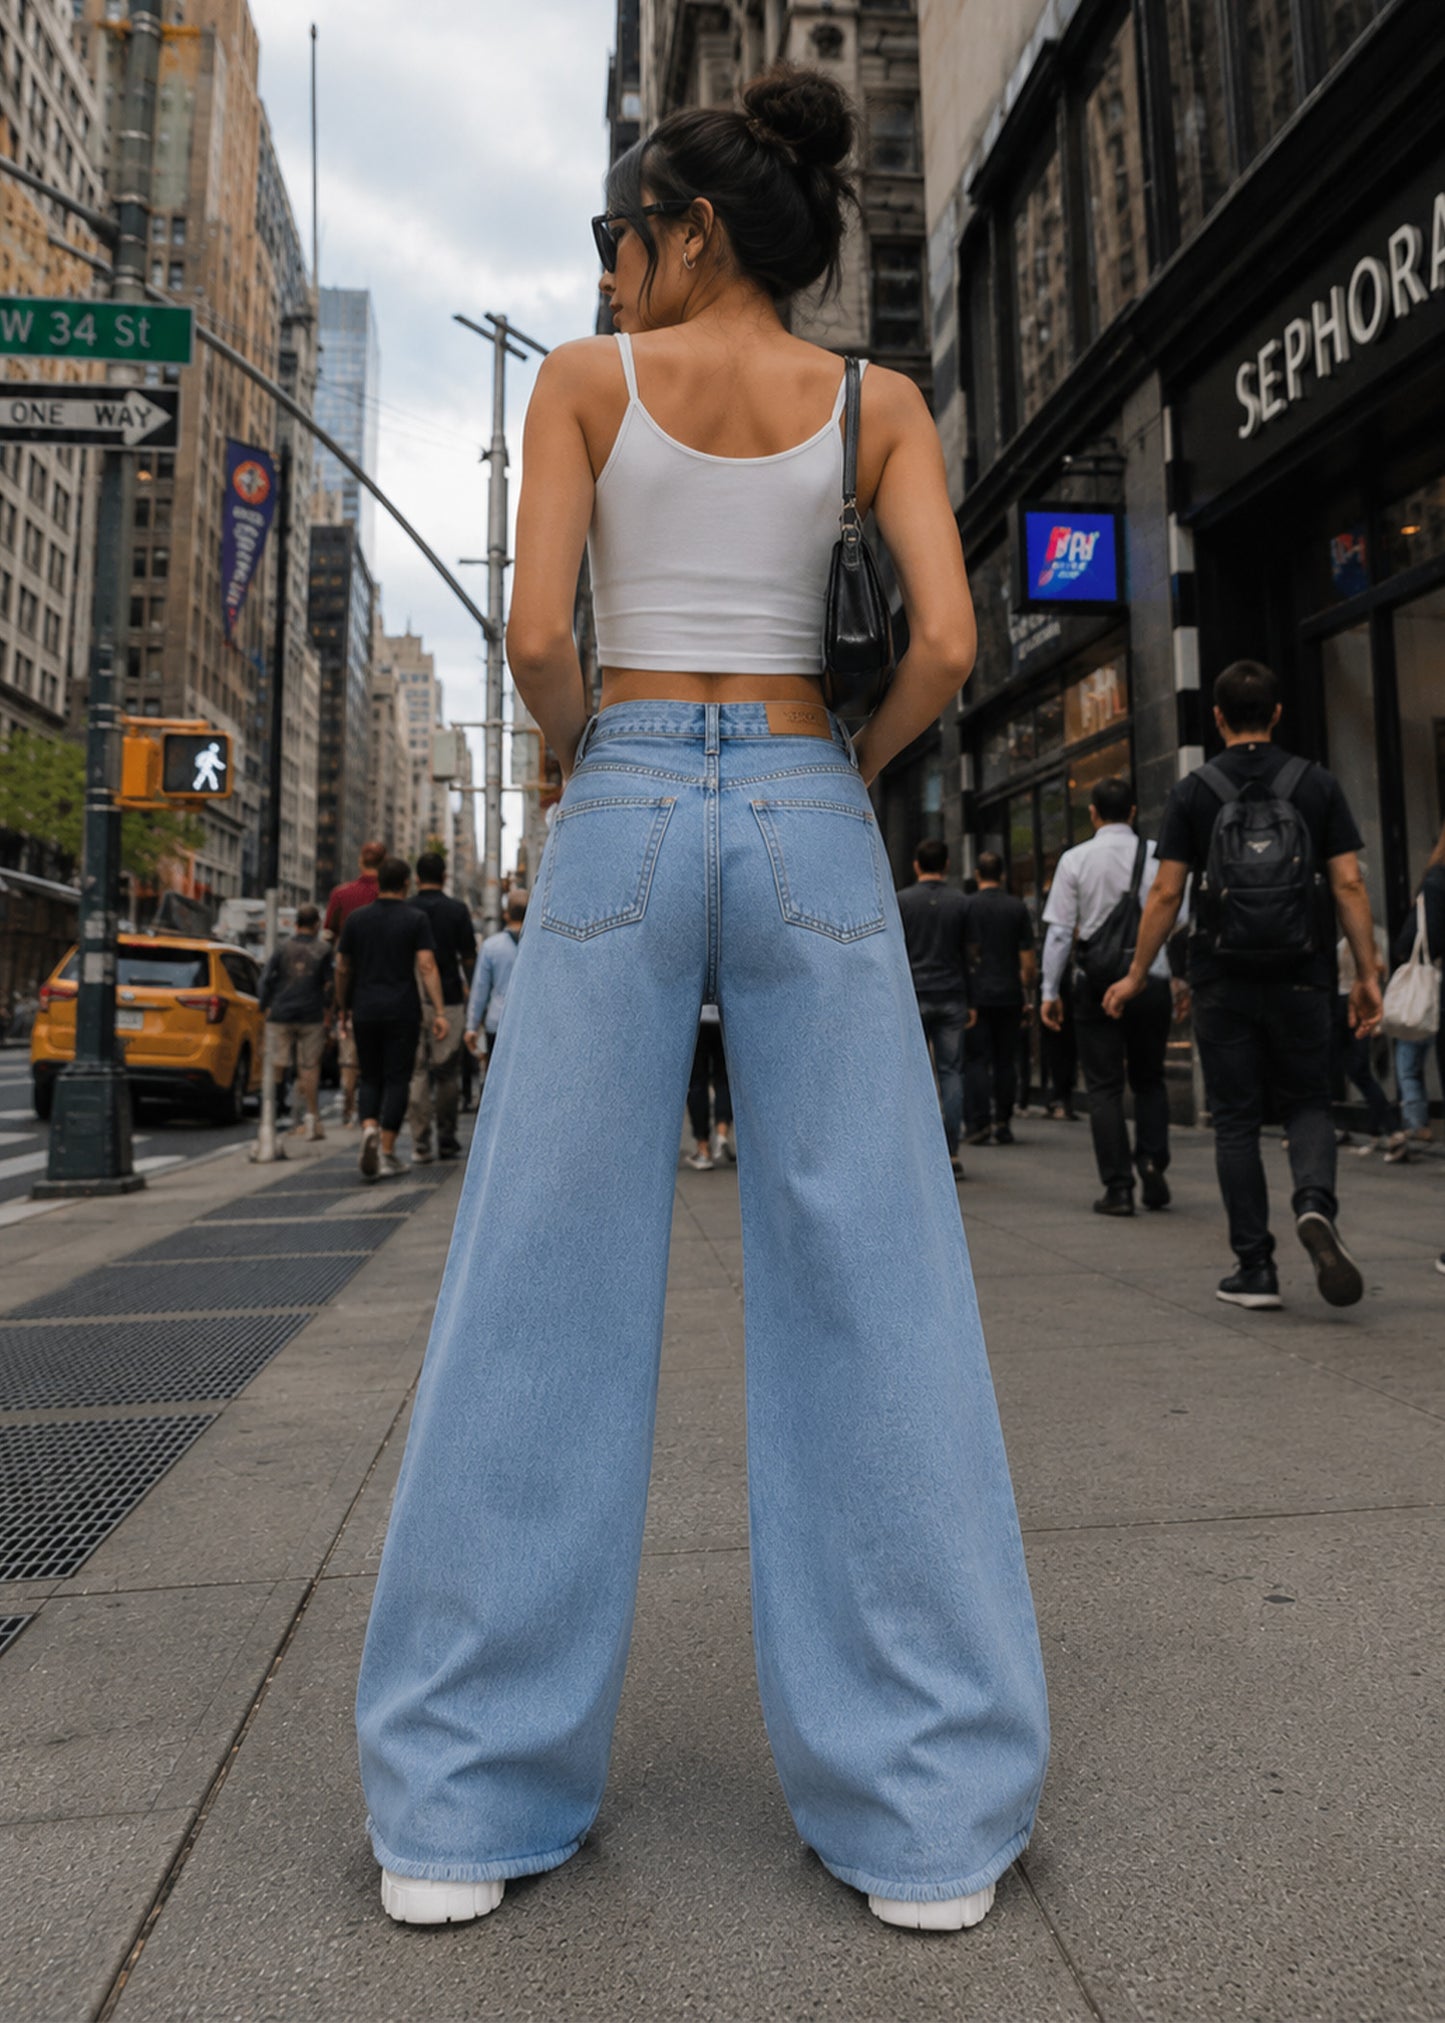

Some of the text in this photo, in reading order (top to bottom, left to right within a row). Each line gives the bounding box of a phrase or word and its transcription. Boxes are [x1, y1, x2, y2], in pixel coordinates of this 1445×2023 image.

[0, 309, 151, 347] W 34 St
[11, 402, 152, 427] ONE WAY
